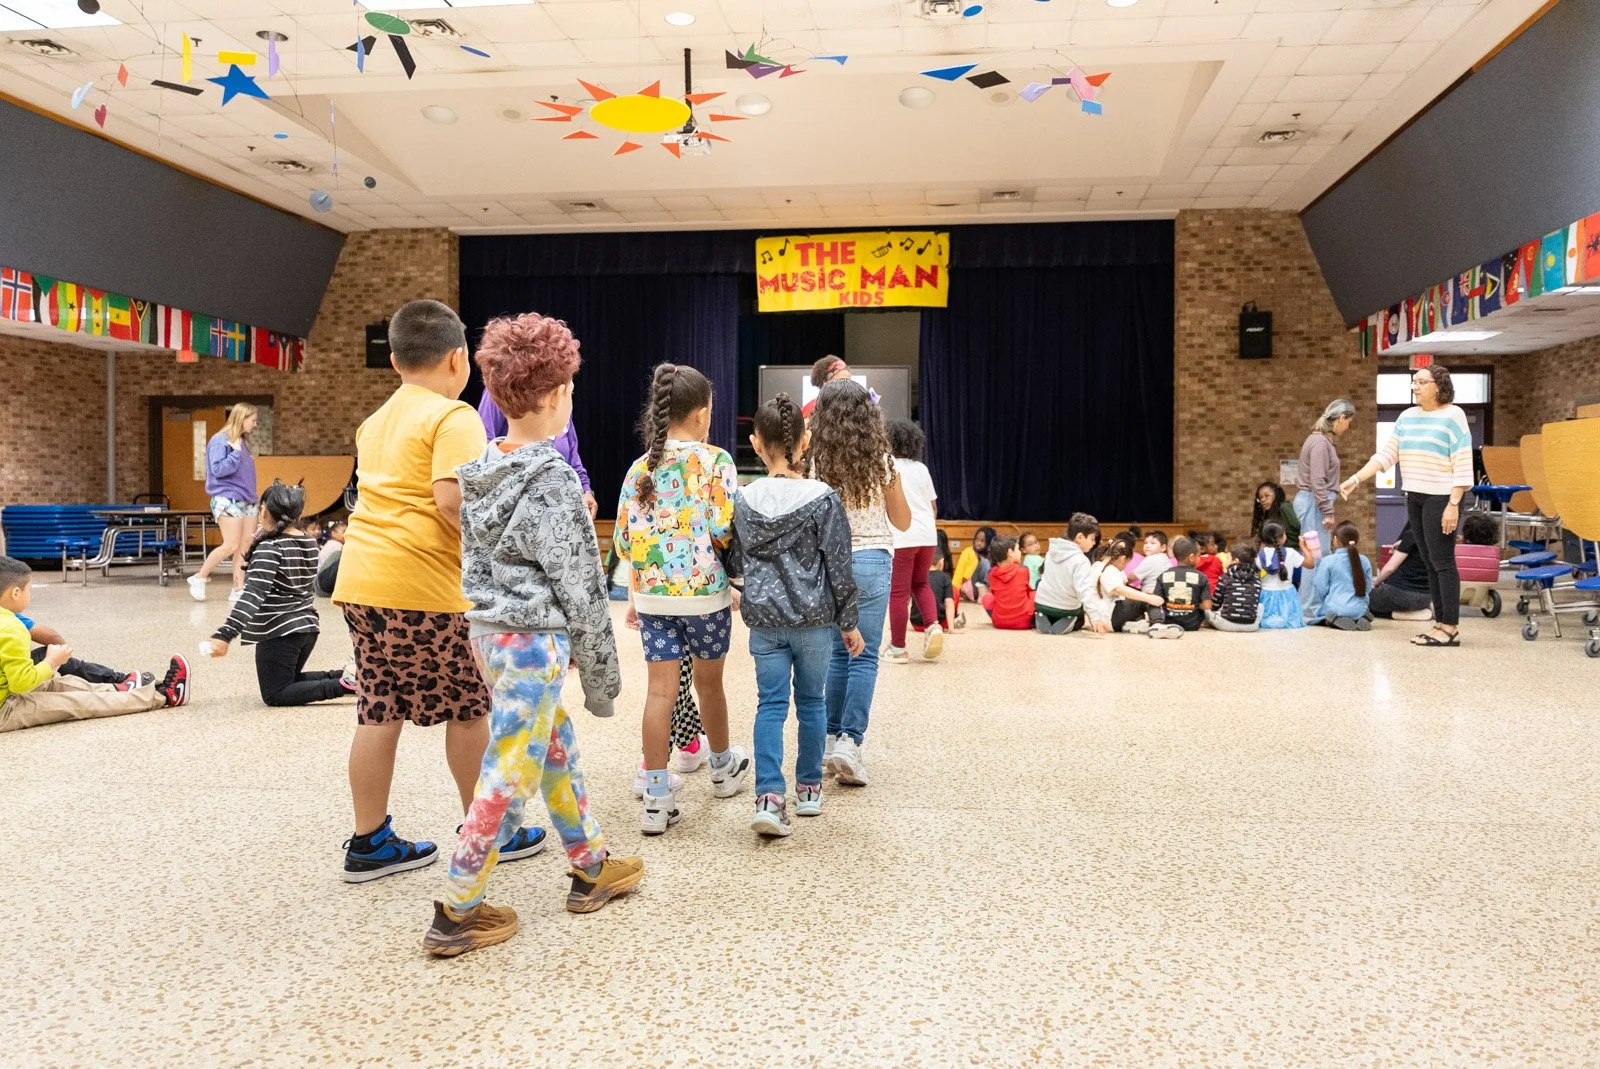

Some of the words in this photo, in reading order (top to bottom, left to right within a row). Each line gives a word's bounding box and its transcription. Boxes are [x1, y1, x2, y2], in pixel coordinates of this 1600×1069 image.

[794, 241, 856, 267] THE
[758, 267, 846, 294] MUSIC
[860, 264, 938, 289] MAN
[839, 291, 884, 305] KIDS
